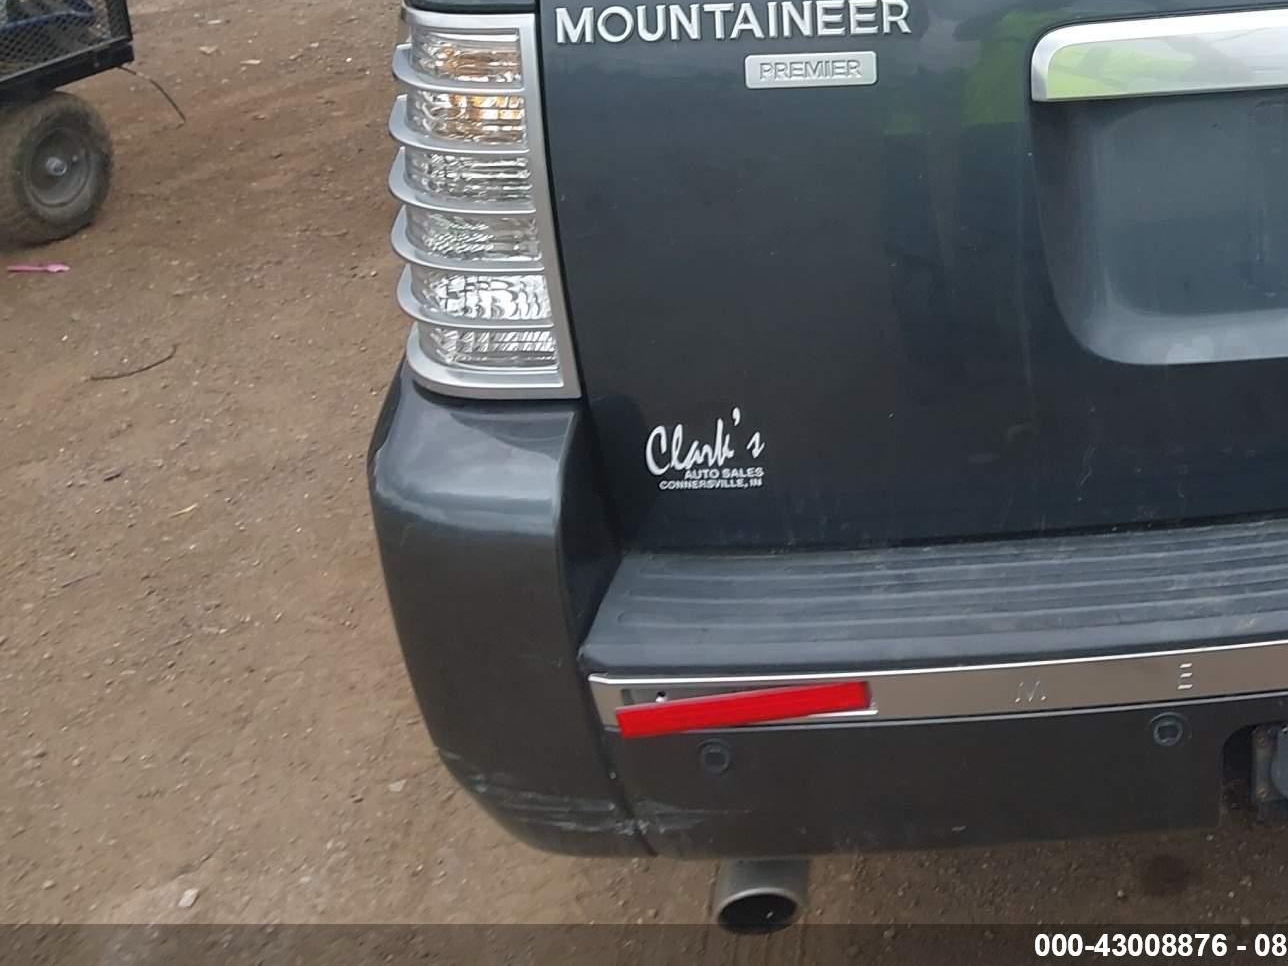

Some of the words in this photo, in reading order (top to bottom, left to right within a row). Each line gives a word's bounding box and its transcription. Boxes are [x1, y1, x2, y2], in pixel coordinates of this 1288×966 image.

[759, 59, 862, 80] PREMIER
[645, 407, 765, 476] Clark's
[684, 468, 720, 480] AUTO
[721, 467, 764, 479] SALES
